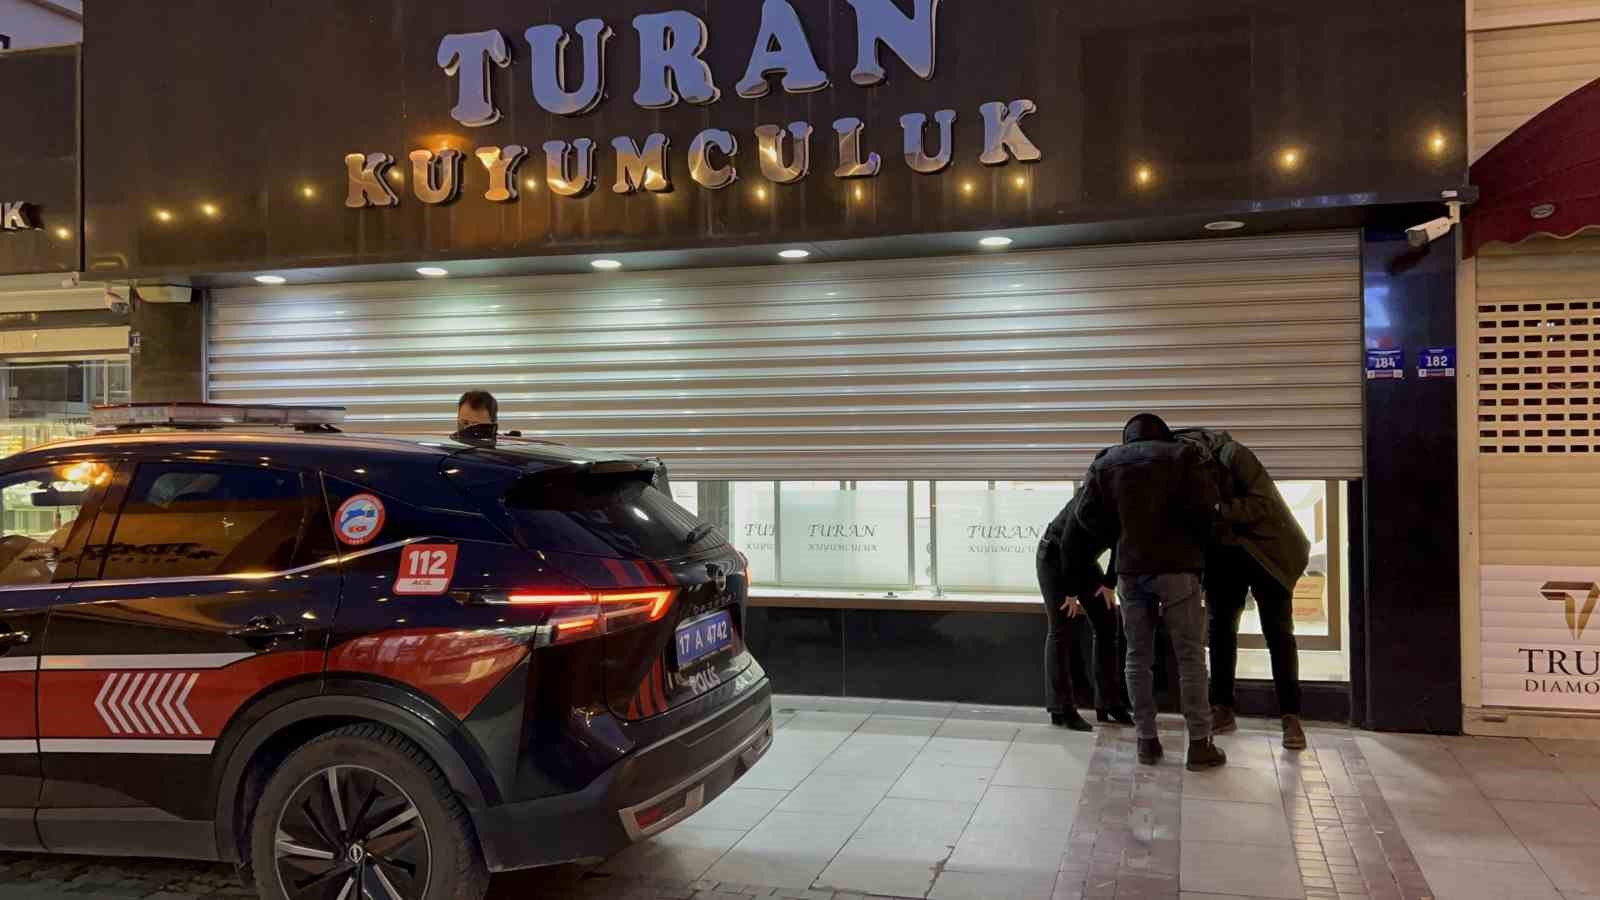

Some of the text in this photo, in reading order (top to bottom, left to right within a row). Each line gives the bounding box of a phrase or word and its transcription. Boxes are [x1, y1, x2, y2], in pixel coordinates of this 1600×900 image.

[437, 0, 937, 127] TURAN
[345, 99, 1041, 208] KUYUMCULUK
[0, 200, 29, 230] K
[1426, 356, 1448, 367] 182
[744, 523, 775, 537] TU
[808, 523, 878, 538] TURAN
[967, 525, 1040, 539] TURAN
[408, 550, 448, 576] 112
[679, 621, 728, 655] 17 A 4742
[1518, 648, 1600, 676] TRU
[1525, 679, 1600, 695] DIAMO
